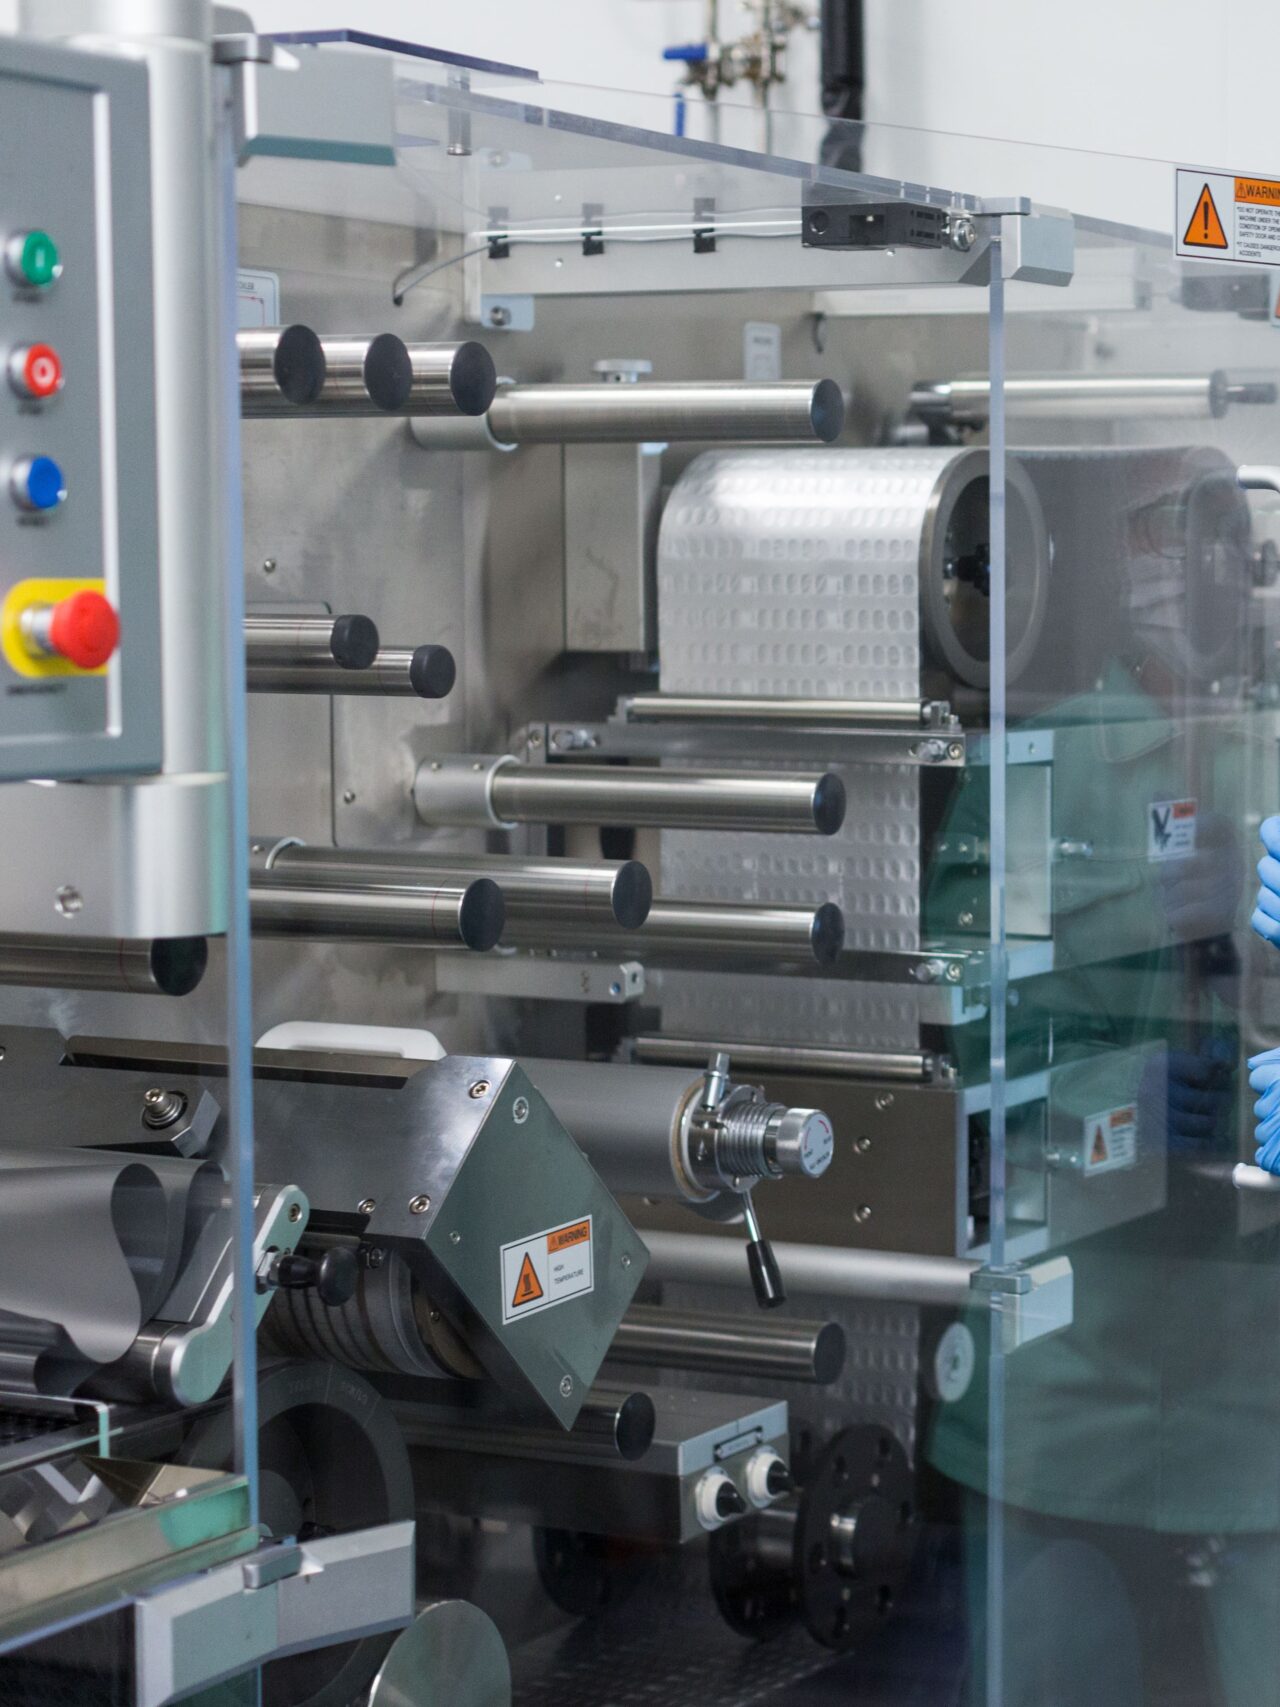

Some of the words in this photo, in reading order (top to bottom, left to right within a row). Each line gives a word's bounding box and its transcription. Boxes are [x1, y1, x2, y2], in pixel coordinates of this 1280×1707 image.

[1255, 208, 1273, 216] OPERATE
[1239, 223, 1261, 231] CONDITION
[1239, 230, 1255, 238] SAFETY
[558, 1226, 588, 1245] WARNING
